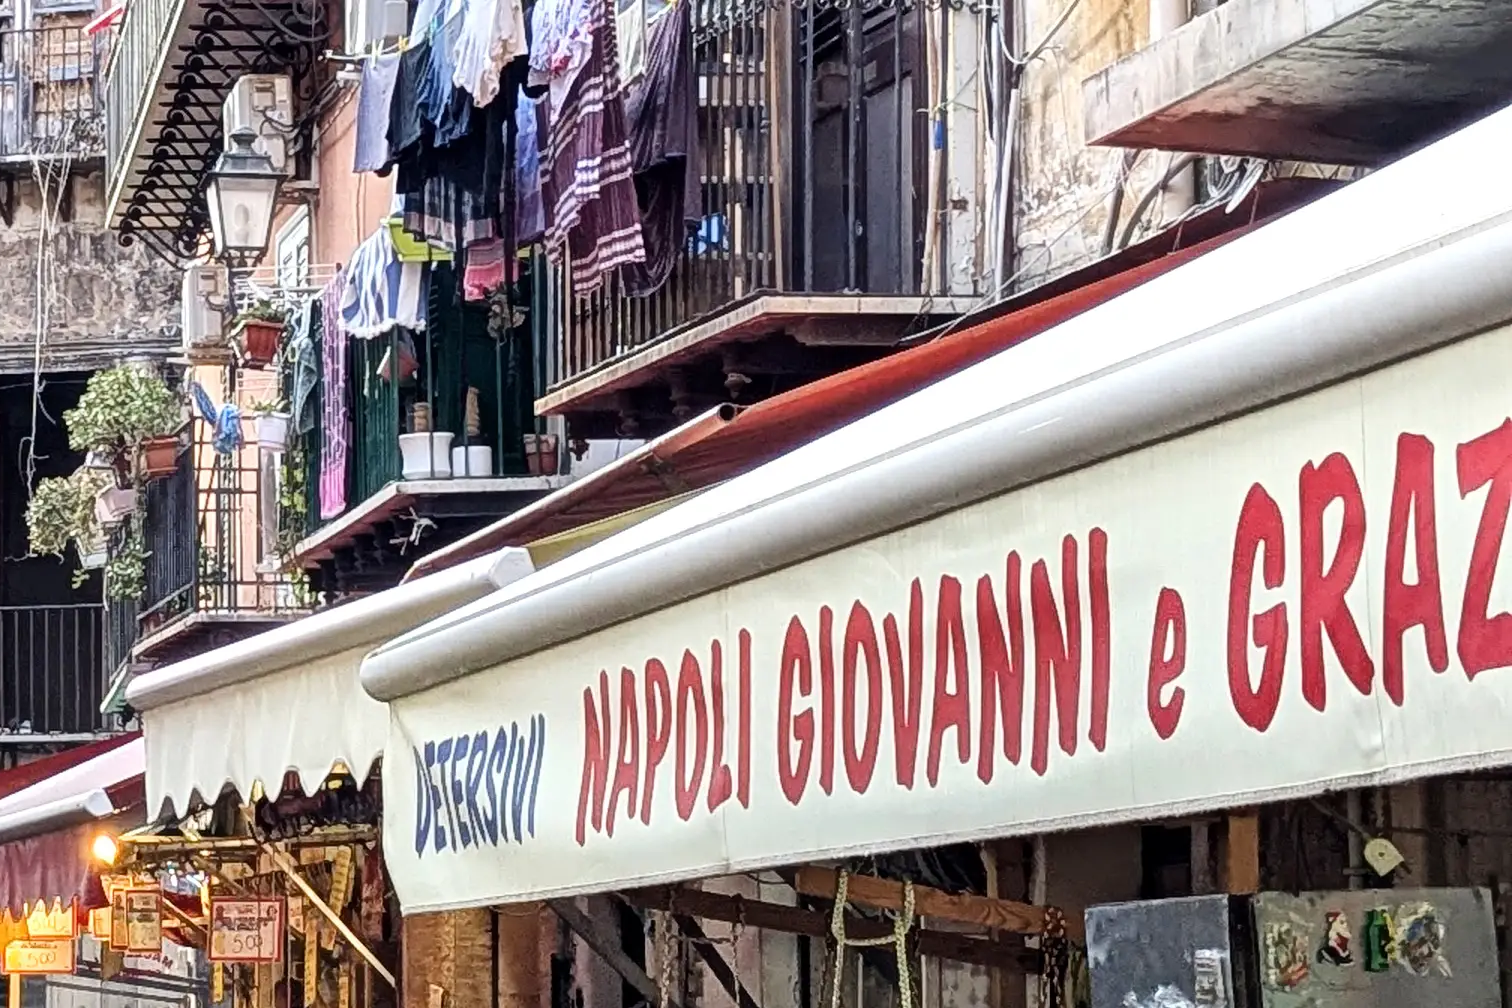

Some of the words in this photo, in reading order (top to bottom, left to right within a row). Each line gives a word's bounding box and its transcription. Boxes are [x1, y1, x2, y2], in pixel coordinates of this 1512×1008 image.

[413, 713, 545, 859] DETERSIVI
[576, 627, 752, 847] NAPOLI
[777, 526, 1110, 806] GIOVANNI
[1148, 587, 1186, 740] e
[1227, 416, 1512, 732] GRAZ
